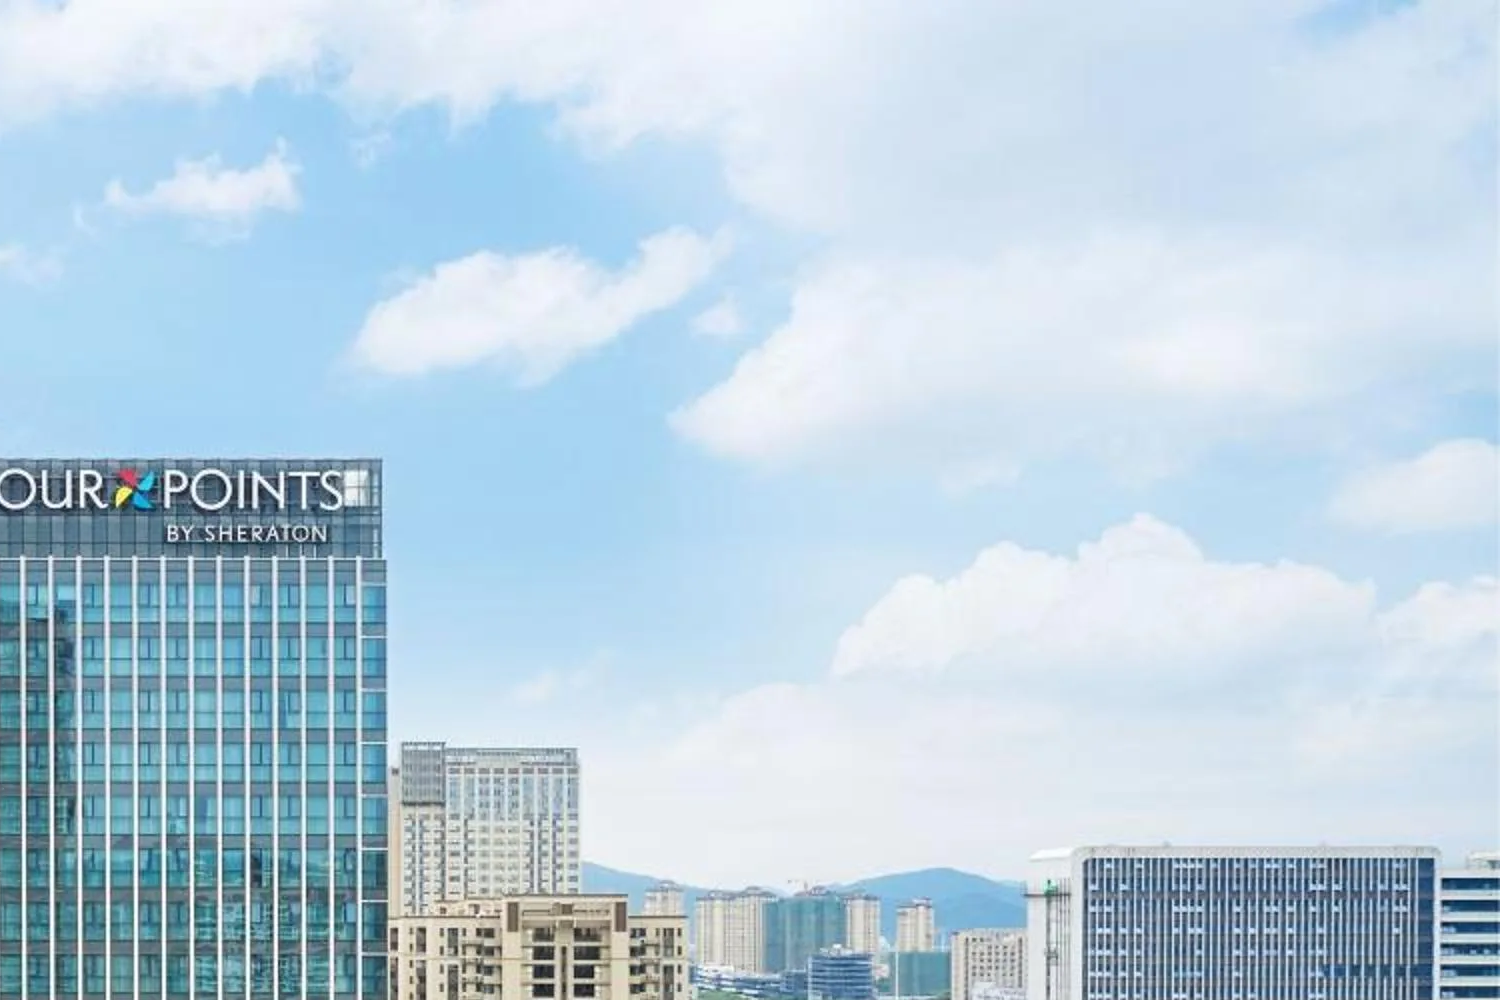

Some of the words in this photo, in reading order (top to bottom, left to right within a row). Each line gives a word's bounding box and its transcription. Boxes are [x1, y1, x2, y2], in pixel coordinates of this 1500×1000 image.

[164, 468, 345, 511] POINTS
[167, 525, 195, 542] BY
[205, 525, 328, 542] SHERATON
